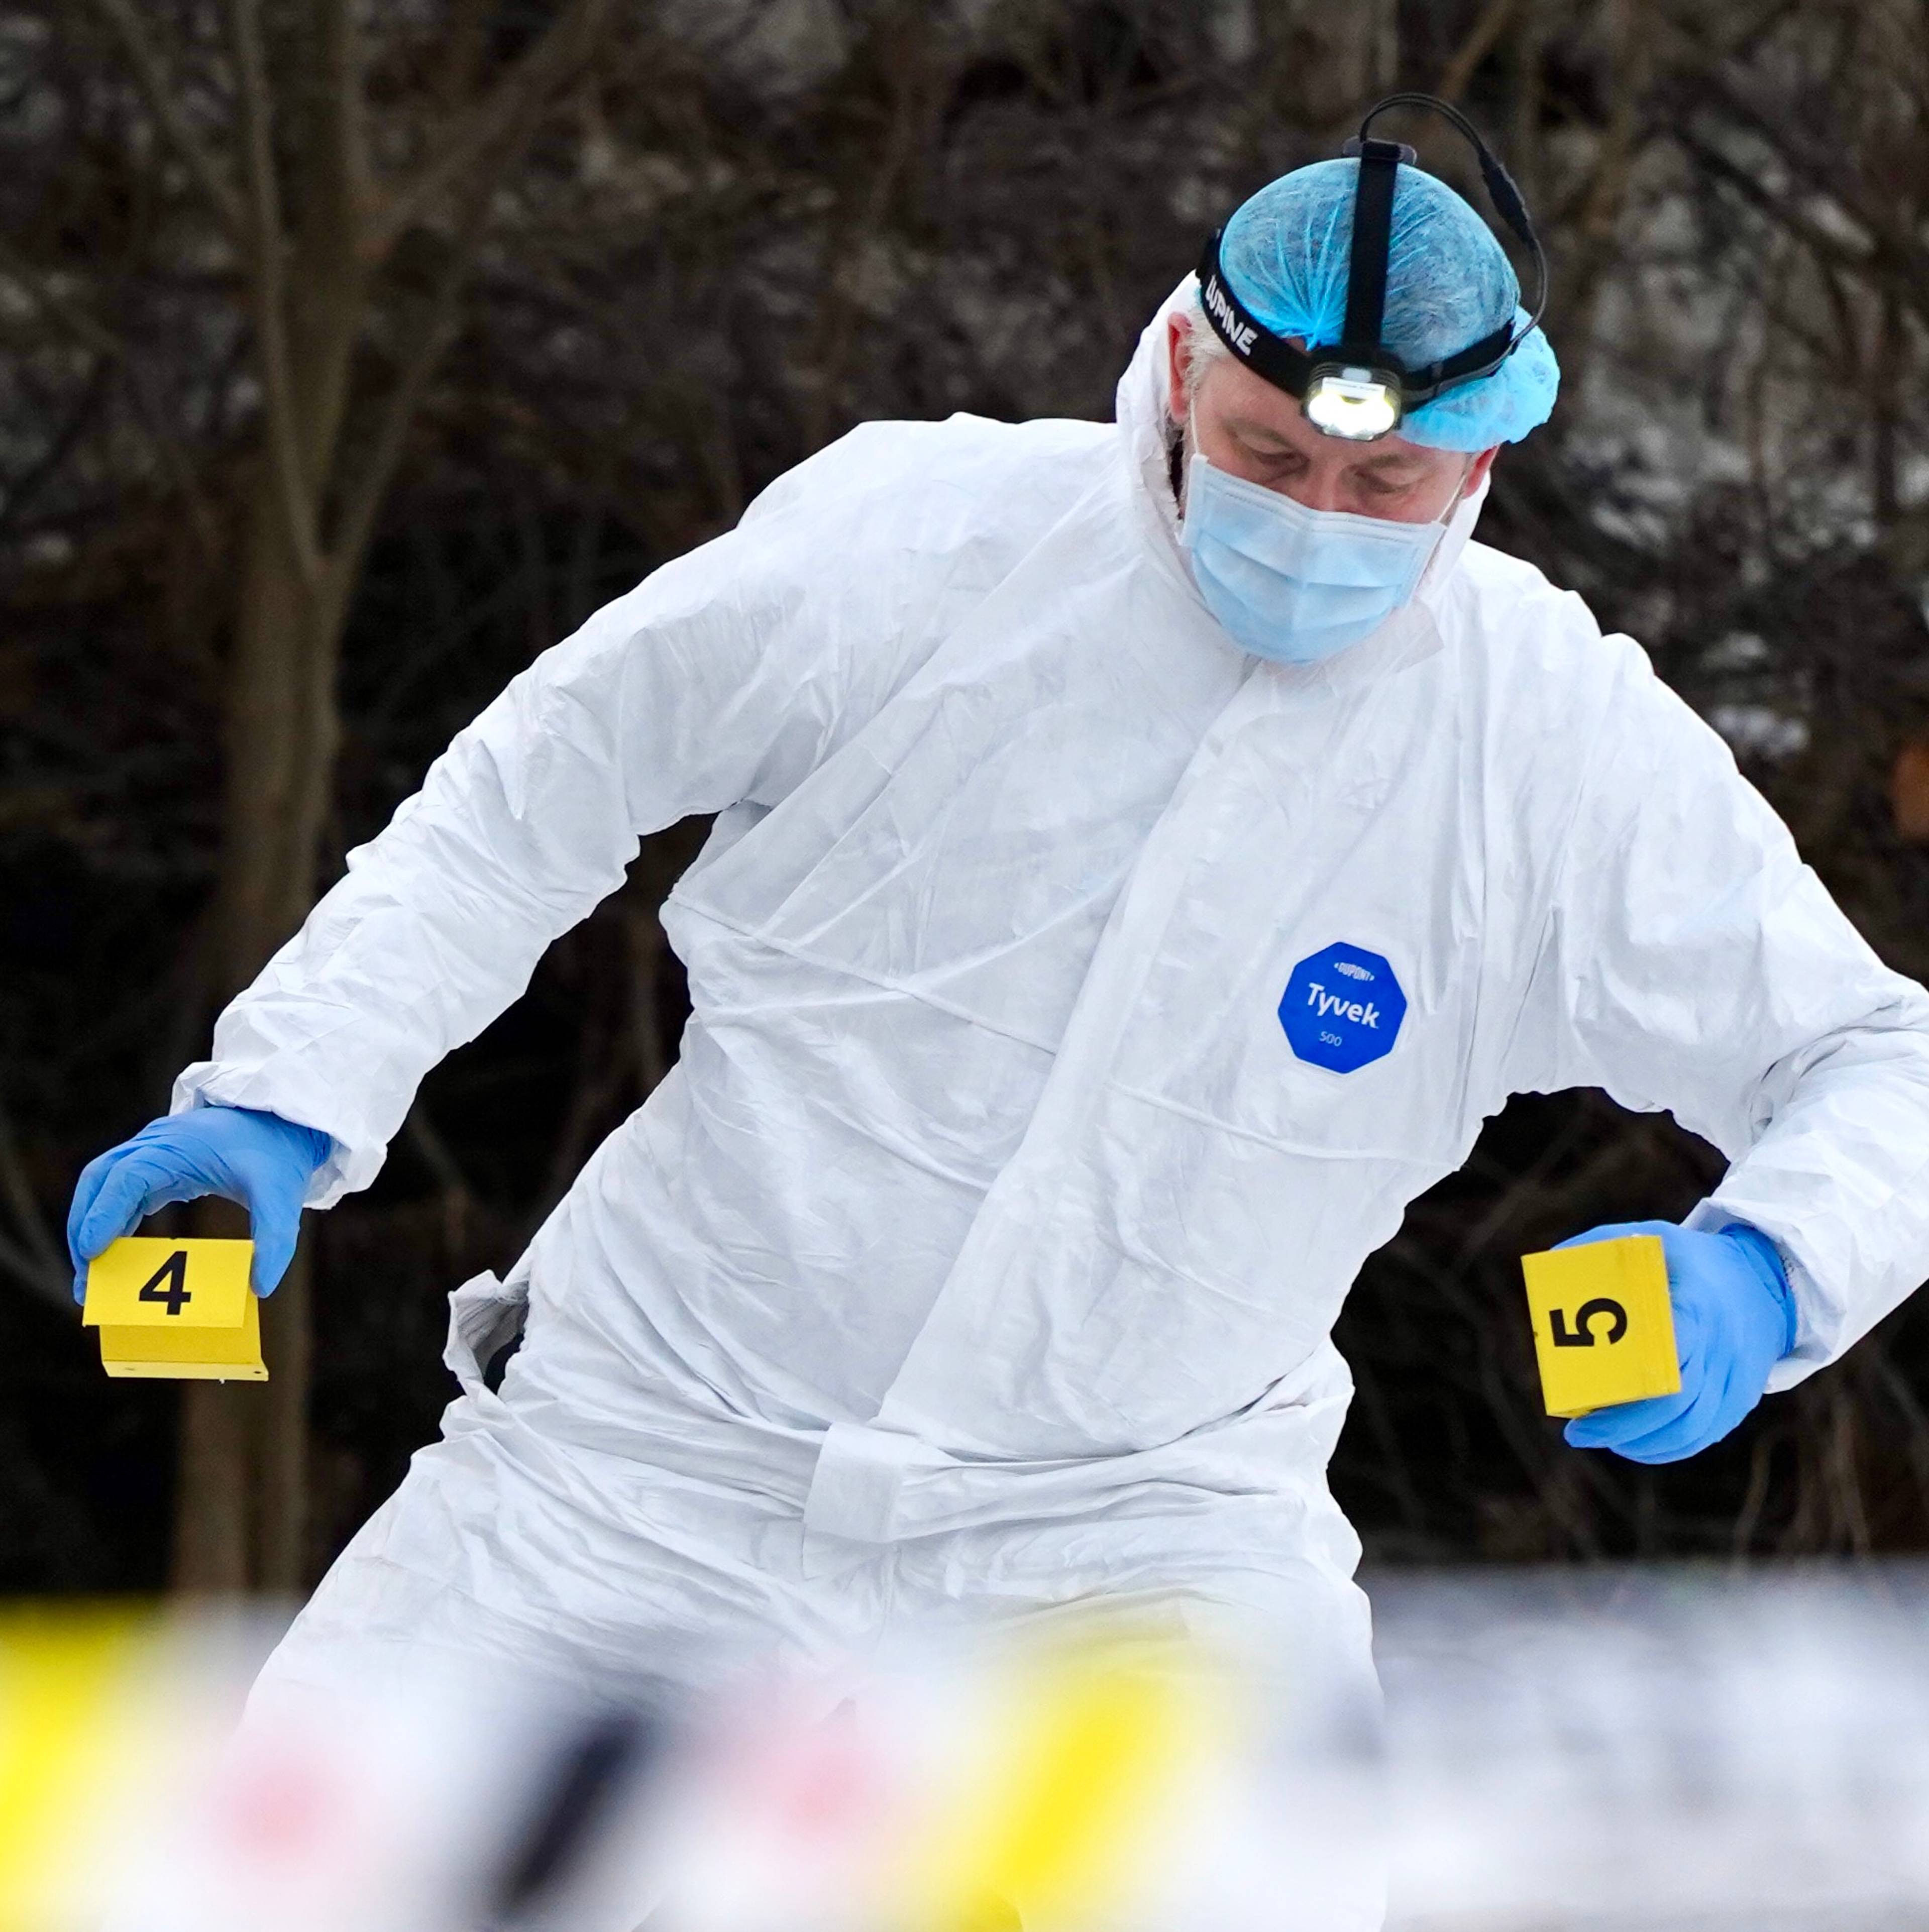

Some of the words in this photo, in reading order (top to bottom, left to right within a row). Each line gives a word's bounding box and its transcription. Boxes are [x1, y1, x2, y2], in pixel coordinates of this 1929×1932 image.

[1206, 275, 1258, 356] LUPINE
[1308, 983, 1380, 1029] Tyvek
[1319, 1031, 1342, 1047] 500
[138, 1251, 192, 1315] 4
[1549, 1298, 1628, 1347] 5
